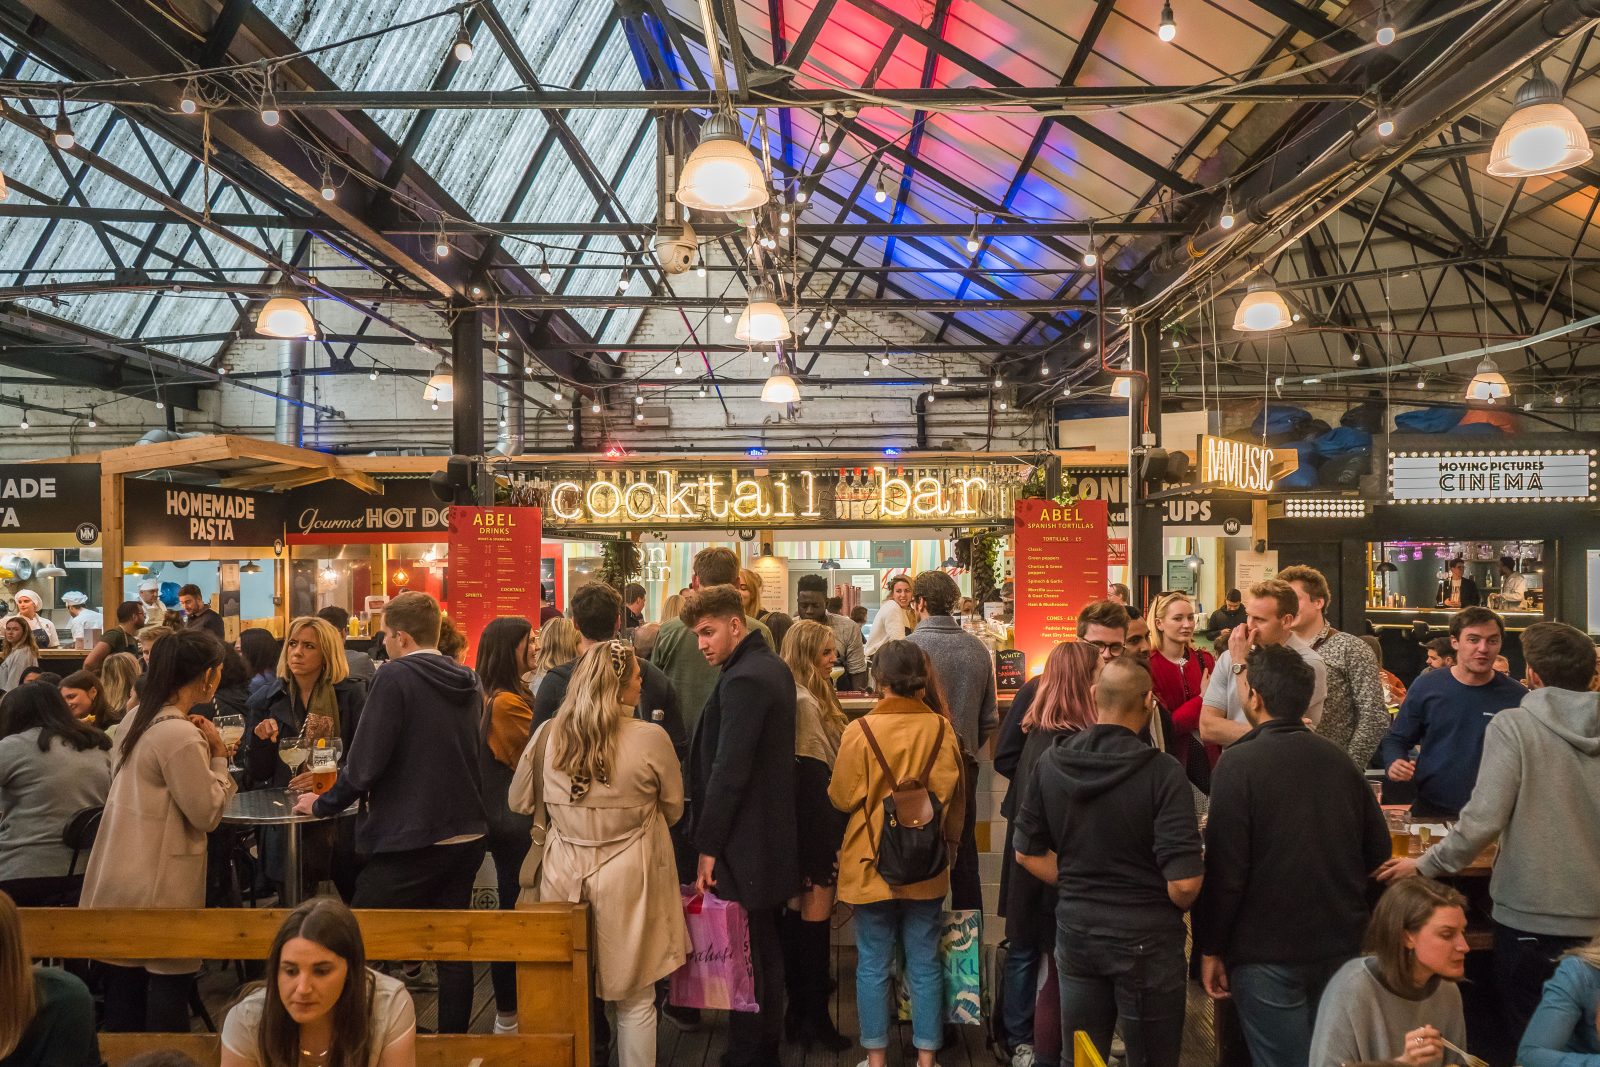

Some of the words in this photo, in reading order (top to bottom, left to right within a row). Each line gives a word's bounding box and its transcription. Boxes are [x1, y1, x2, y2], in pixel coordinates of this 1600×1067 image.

[1439, 462, 1489, 472] MOVING
[1491, 461, 1544, 471] PICTURES
[0, 478, 56, 498] ADE
[1439, 472, 1543, 491] CINEMA
[551, 470, 821, 518] cocktail
[873, 466, 987, 515] bar
[166, 490, 255, 519] HOMEMADE
[1040, 508, 1083, 521] ABEL
[0, 507, 20, 527] A
[298, 508, 365, 536] Gourmet
[366, 507, 416, 529] HOT
[473, 513, 516, 526] ABEL
[190, 517, 234, 540] PASTA
[479, 527, 510, 535] DRINKS
